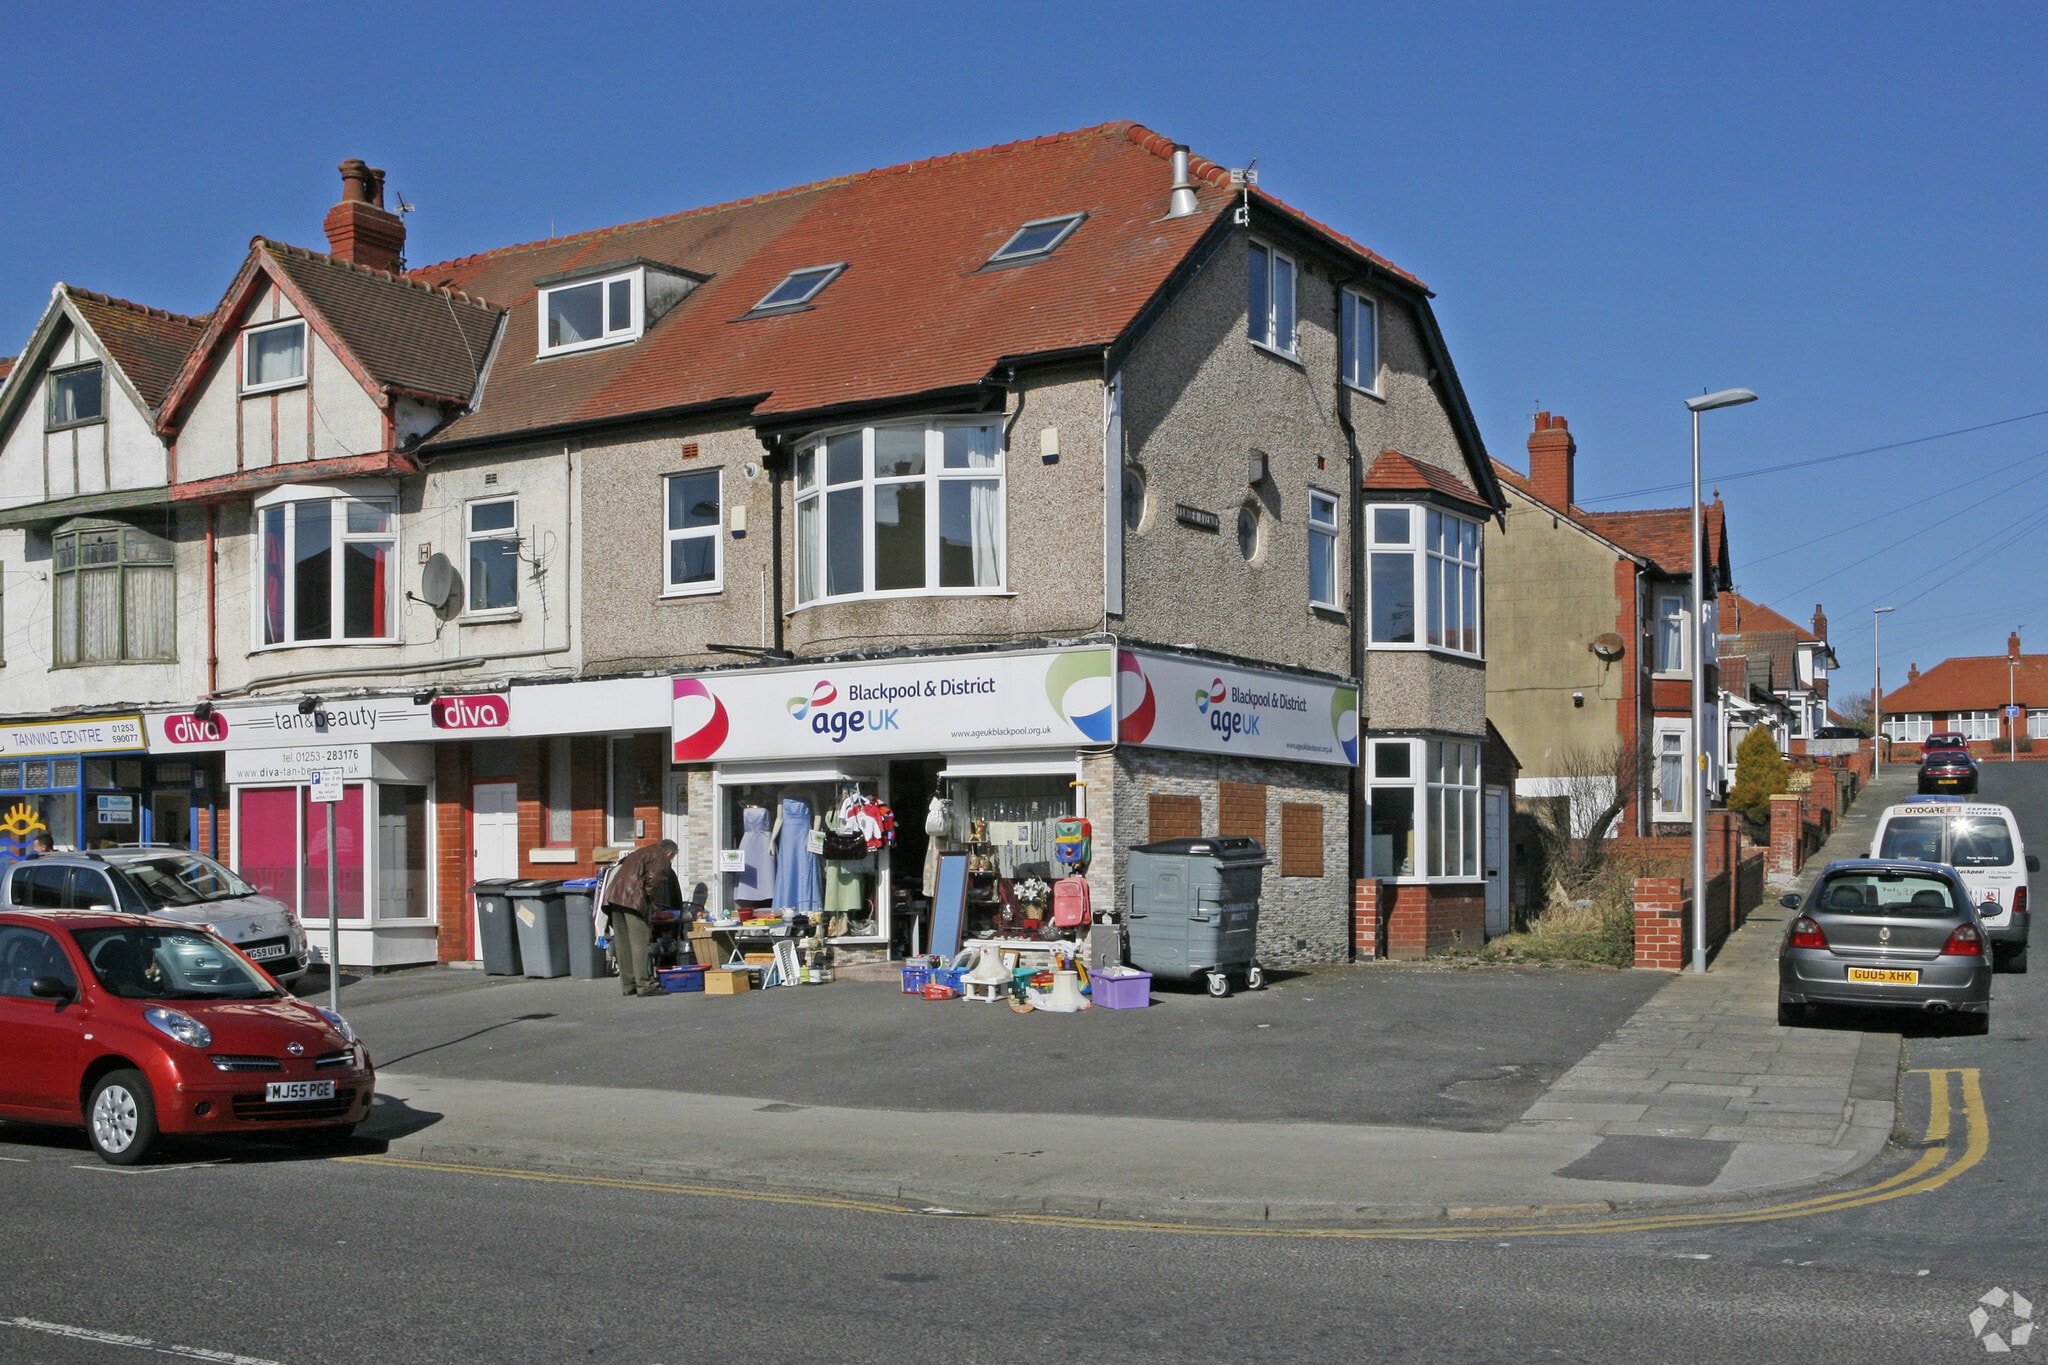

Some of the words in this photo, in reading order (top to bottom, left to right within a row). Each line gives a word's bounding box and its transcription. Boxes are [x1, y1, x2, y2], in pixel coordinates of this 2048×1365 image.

[850, 681, 921, 703] Blackpool
[924, 680, 937, 697] &
[940, 676, 996, 696] District
[1232, 687, 1270, 709] Blackpool
[1272, 694, 1279, 708] &
[1280, 694, 1307, 712] District
[444, 698, 499, 728] diva
[112, 723, 135, 733] 01253
[174, 716, 220, 743] diva
[951, 726, 1052, 738] www.ageukblackpool.org.uk
[12, 731, 58, 747] TANNING
[60, 728, 104, 744] CENTRE
[112, 734, 139, 744] 590077
[1888, 971, 1913, 981] XHK
[272, 1084, 307, 1099] MJ55
[310, 1082, 331, 1097] PGE
